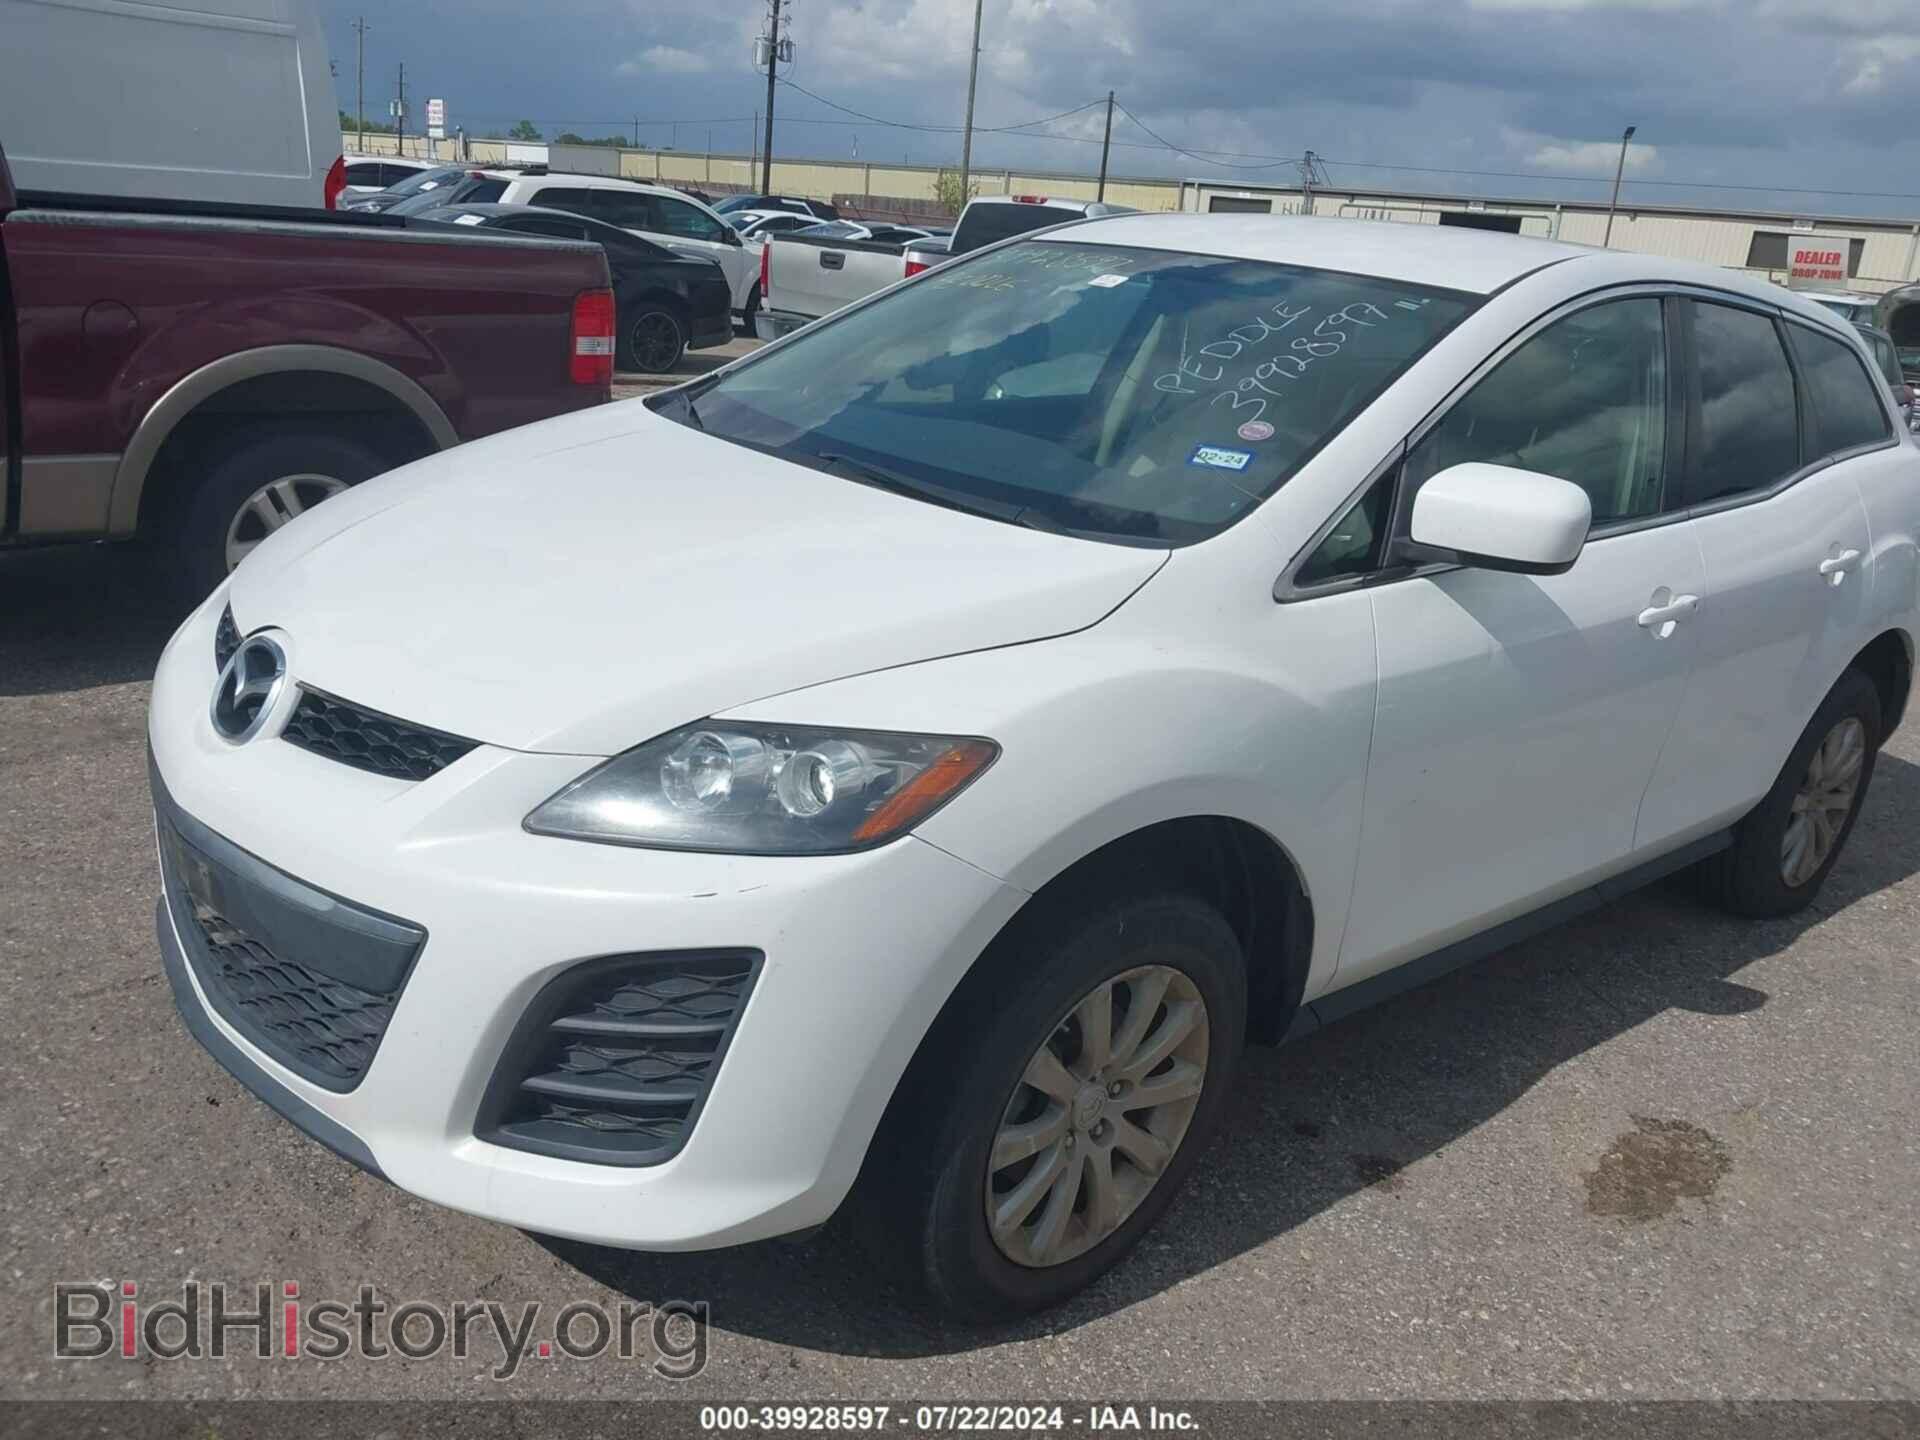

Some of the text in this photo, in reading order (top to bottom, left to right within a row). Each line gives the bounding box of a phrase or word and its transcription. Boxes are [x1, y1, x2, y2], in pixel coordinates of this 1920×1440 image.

[1795, 250, 1841, 265] DEALER
[1818, 269, 1842, 280] ZONE
[1153, 297, 1311, 395] PEDDLE
[1210, 302, 1388, 423] 39928597
